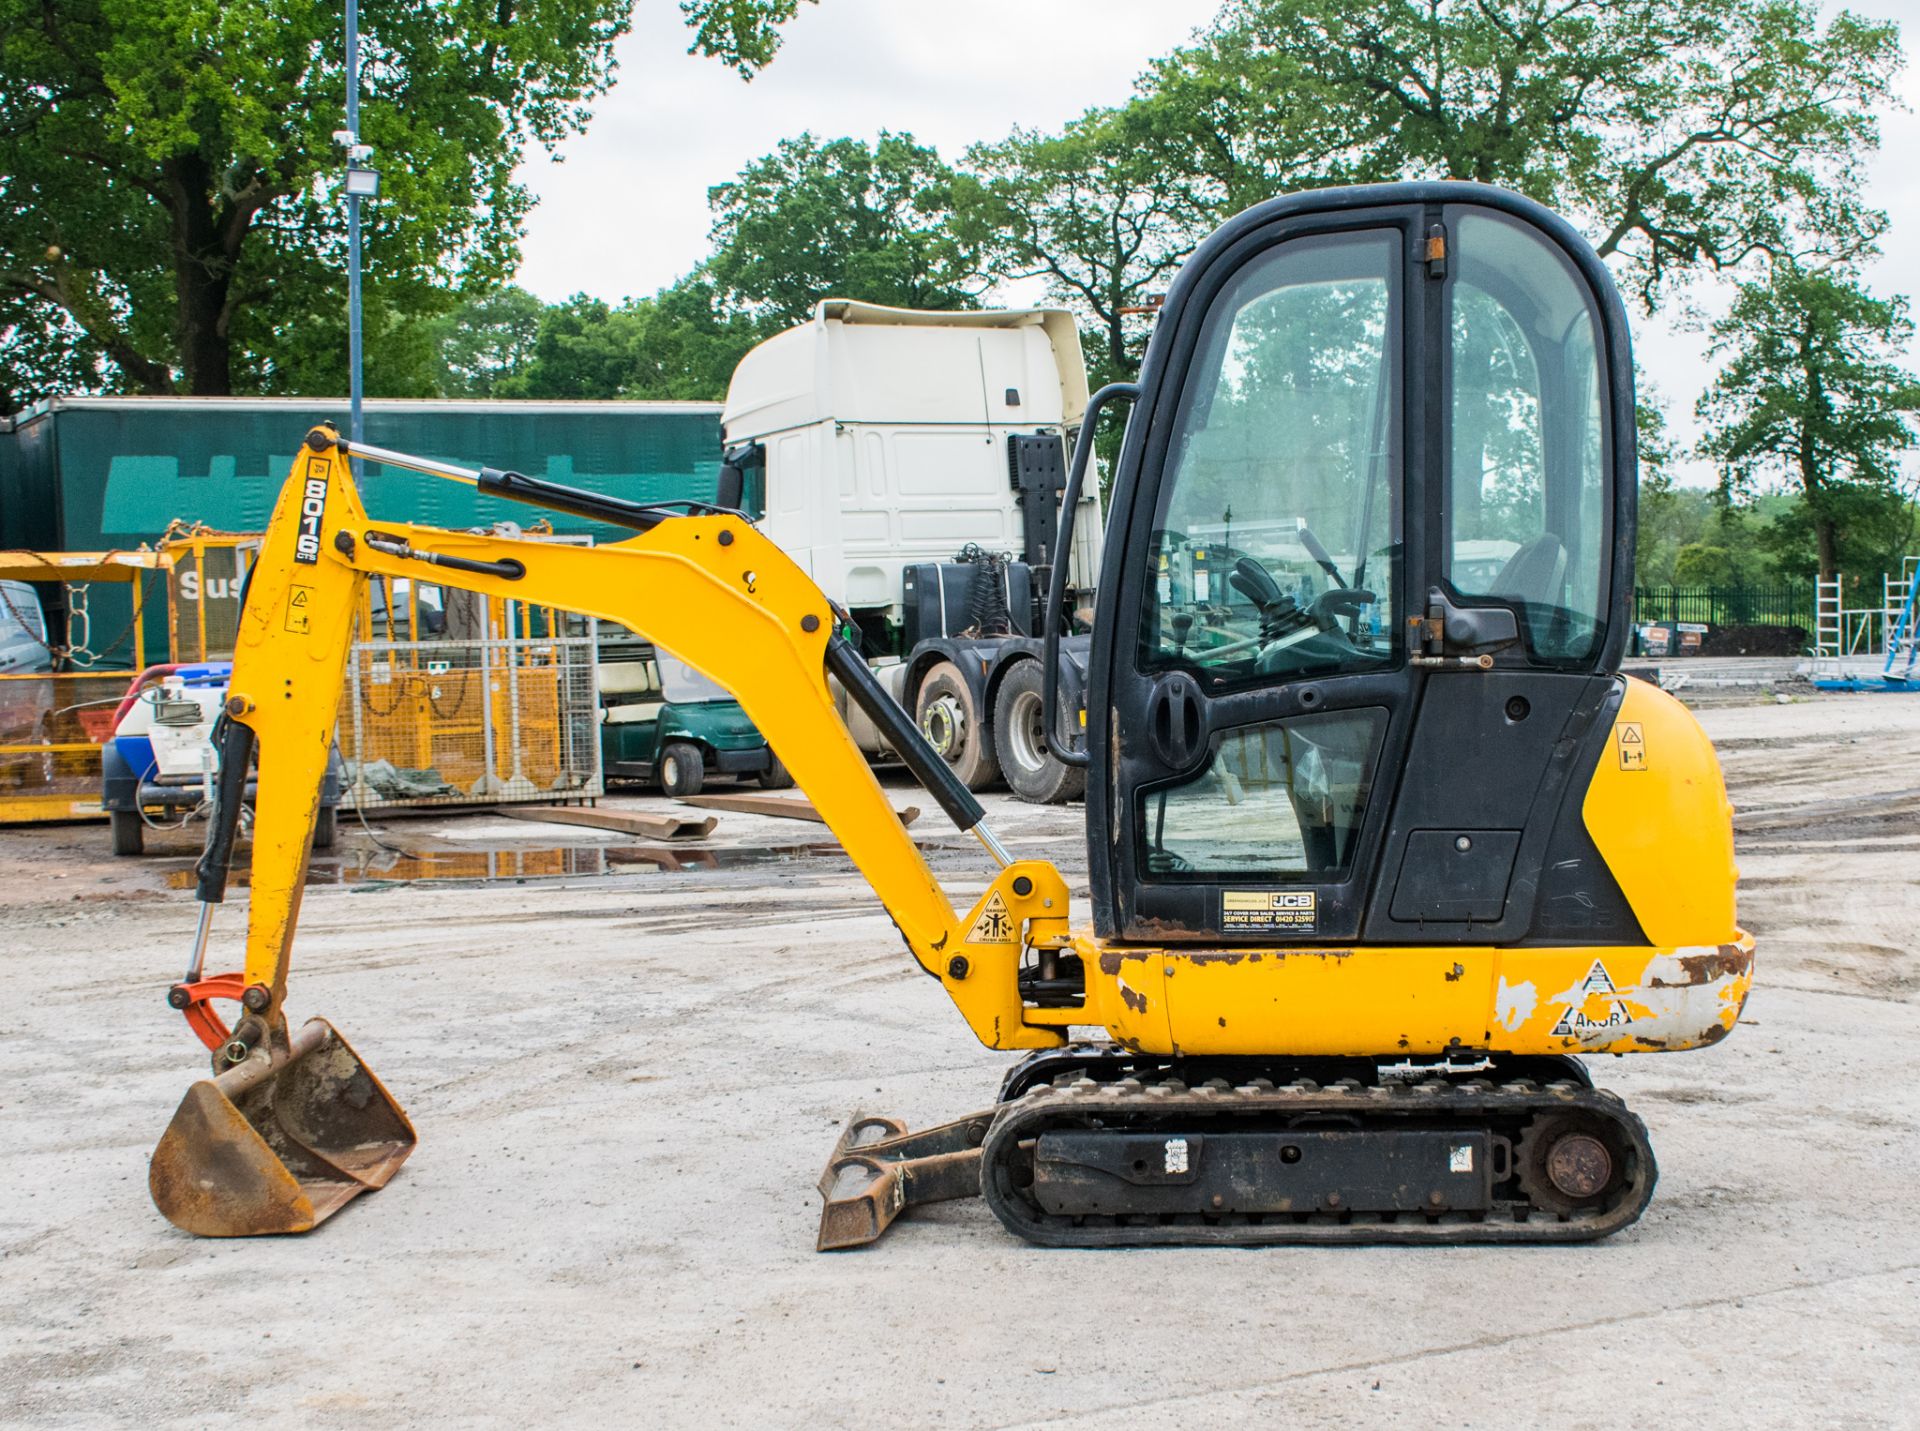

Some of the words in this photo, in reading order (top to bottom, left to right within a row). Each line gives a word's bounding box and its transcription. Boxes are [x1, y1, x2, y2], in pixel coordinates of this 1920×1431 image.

[297, 479, 327, 554] 8016
[296, 552, 317, 561] CTS
[1272, 895, 1312, 907] JCB
